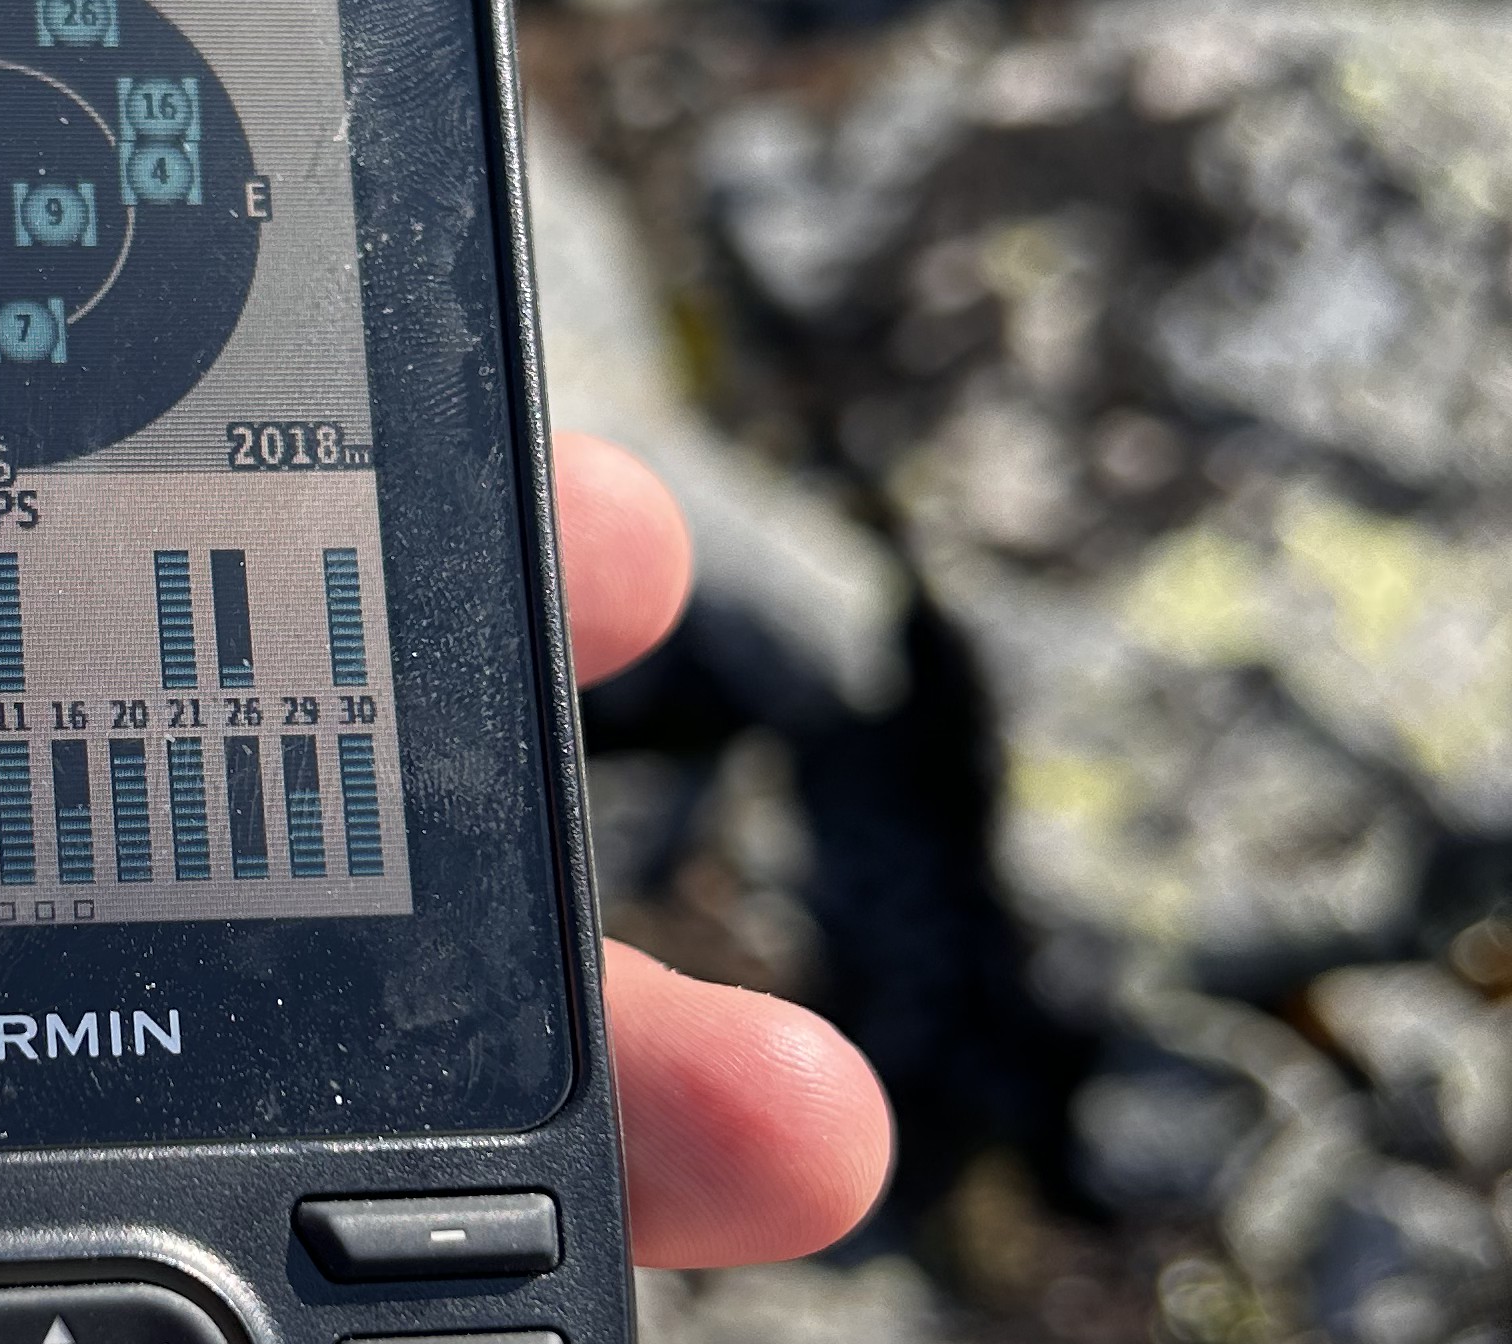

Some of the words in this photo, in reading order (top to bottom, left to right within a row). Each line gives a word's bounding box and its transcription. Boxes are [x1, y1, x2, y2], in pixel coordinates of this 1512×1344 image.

[63, 0, 99, 27] 26
[141, 93, 178, 121] 16
[152, 157, 170, 185] 4
[45, 198, 64, 226] 9
[245, 183, 267, 218] E
[14, 314, 31, 343] 7
[51, 701, 88, 730] 16
[110, 700, 149, 729] 20
[167, 699, 207, 728] 21
[224, 698, 263, 727] 26
[281, 697, 319, 725] 29
[338, 696, 377, 725] 30
